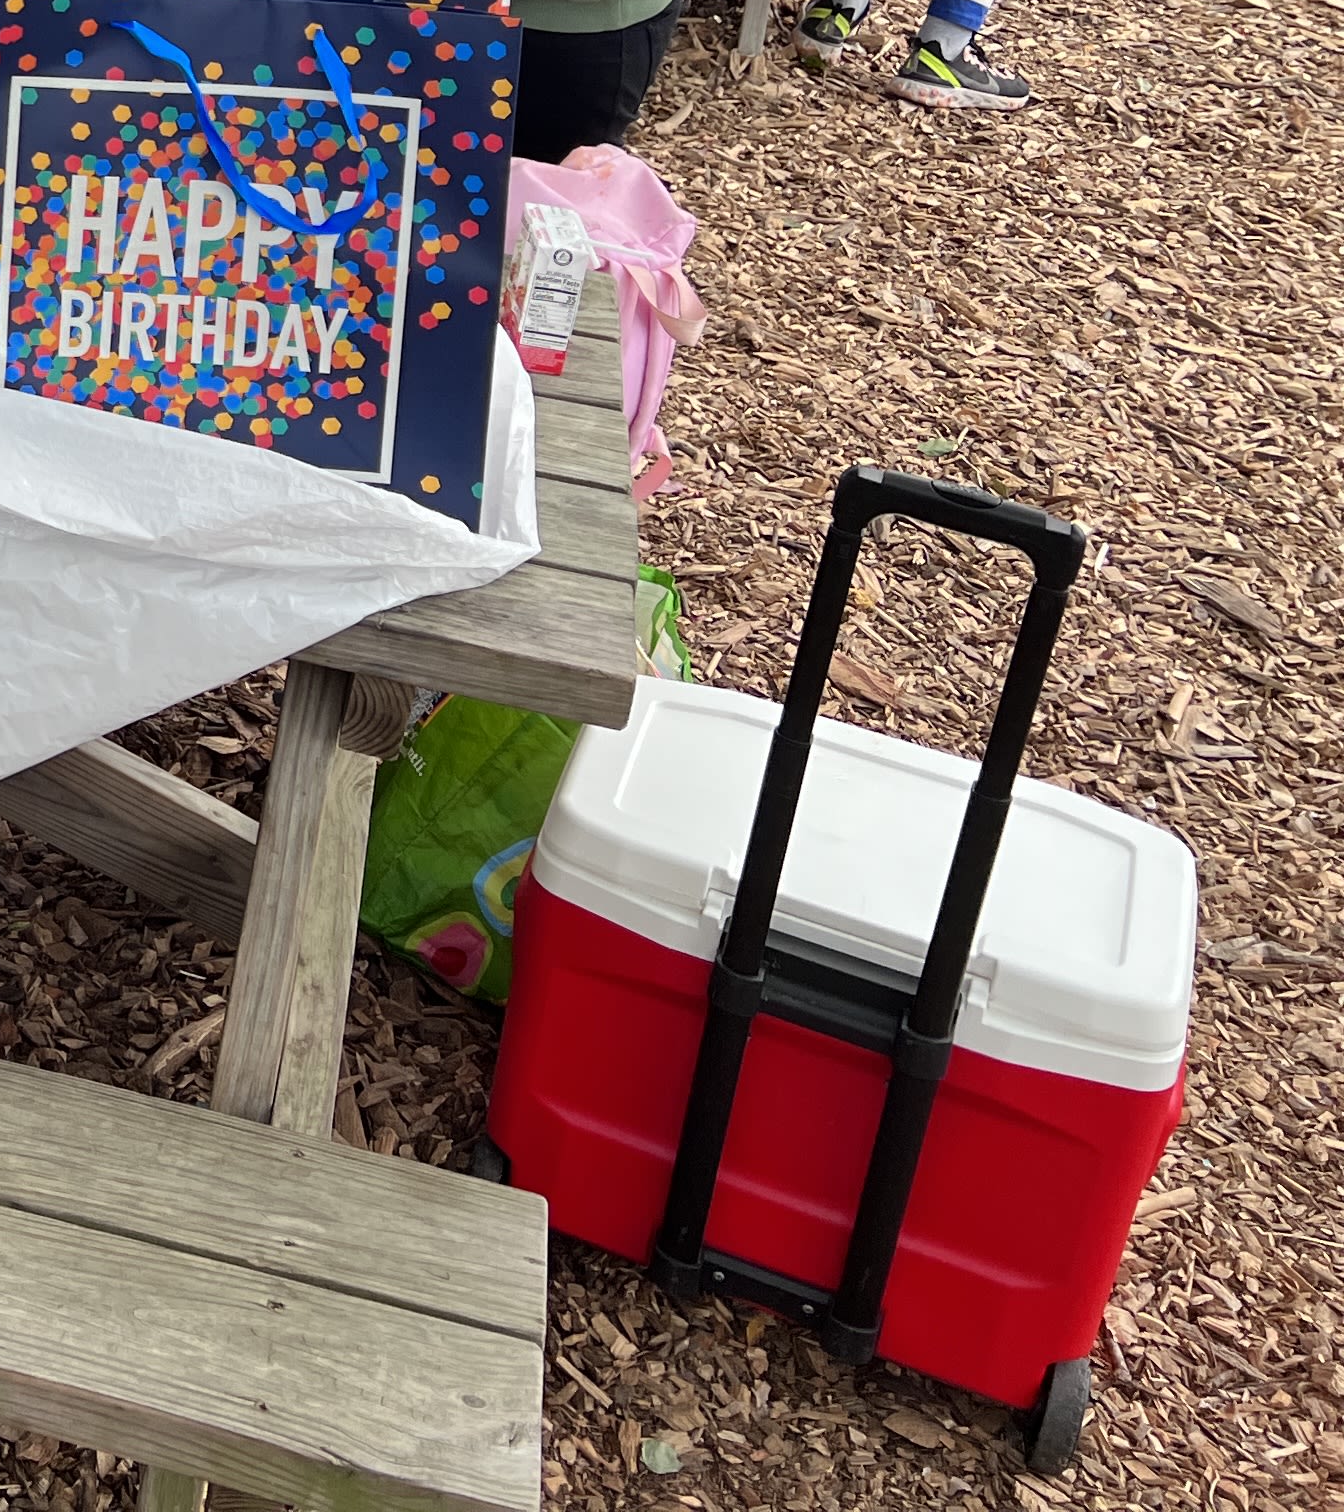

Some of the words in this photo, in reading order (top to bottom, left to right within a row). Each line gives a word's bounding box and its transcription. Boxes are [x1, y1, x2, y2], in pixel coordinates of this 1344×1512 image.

[65, 175, 359, 290] HAPPY
[562, 278, 580, 288] Facts
[58, 289, 349, 374] BIRTHDAY
